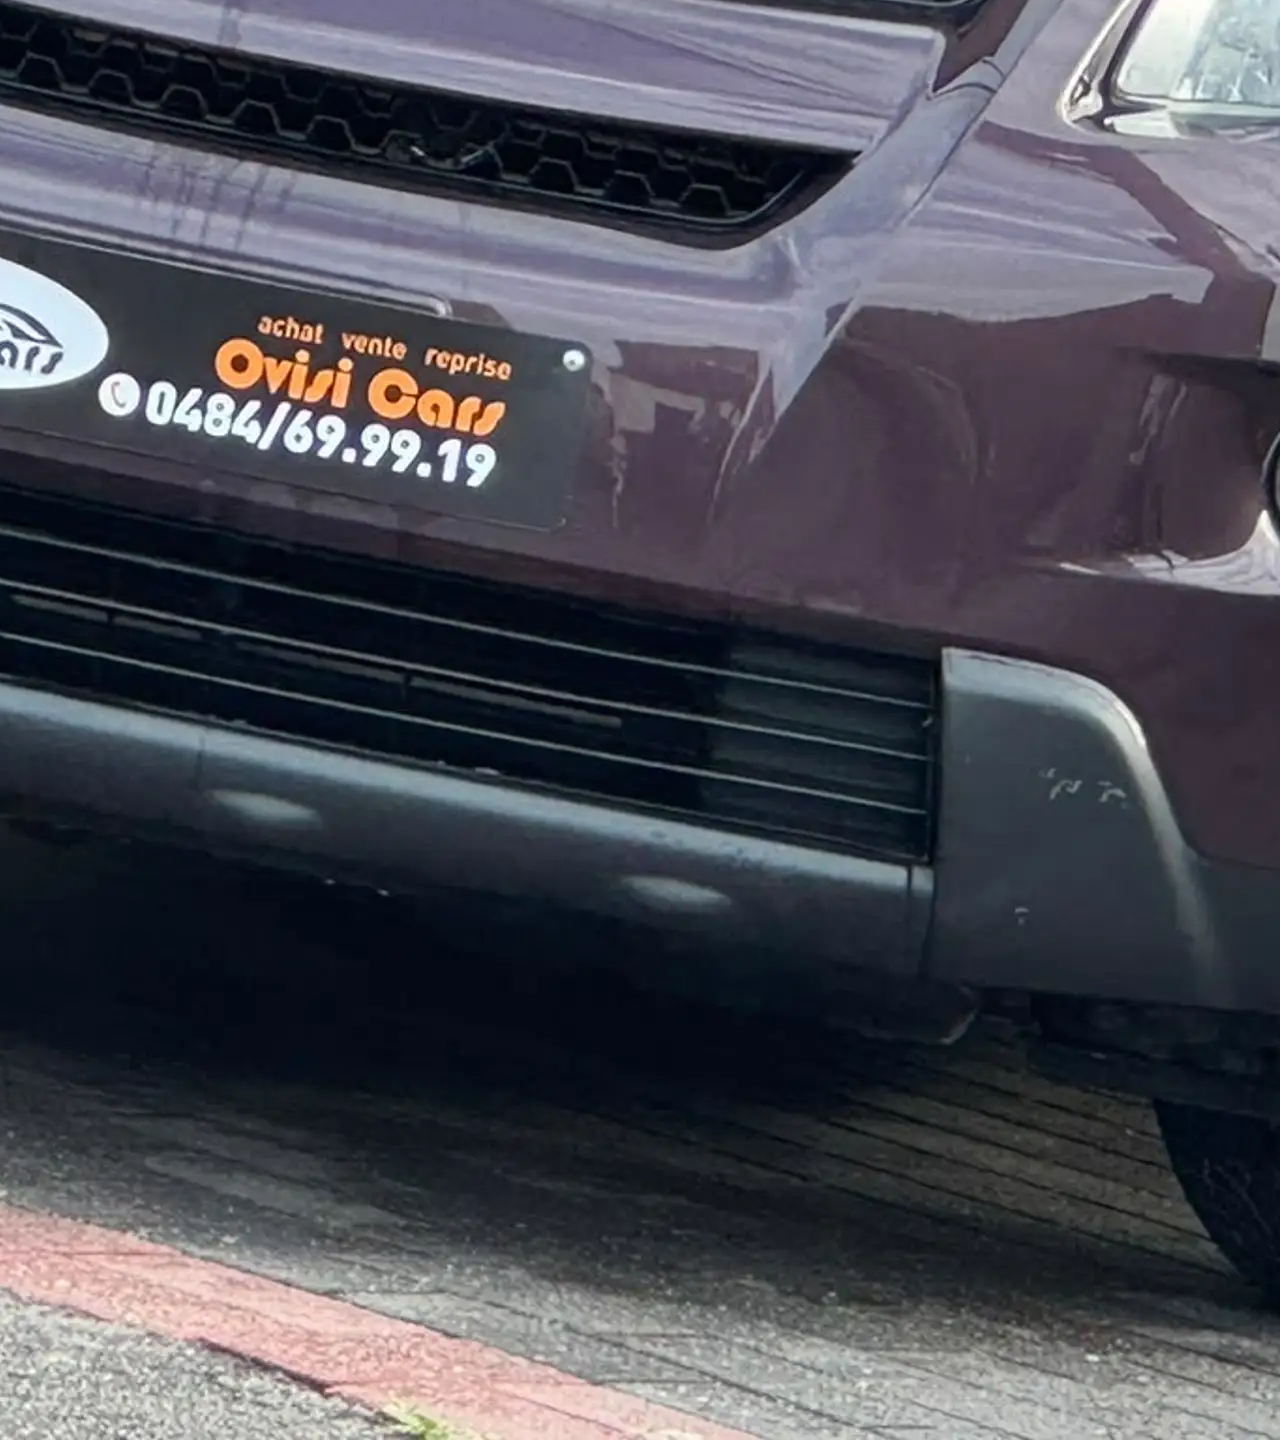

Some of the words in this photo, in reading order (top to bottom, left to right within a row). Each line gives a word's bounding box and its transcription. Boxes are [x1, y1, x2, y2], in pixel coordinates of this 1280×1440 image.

[214, 338, 354, 409] Ovisi
[367, 367, 506, 436] Cars
[257, 315, 324, 344] achat
[341, 331, 408, 360] vente
[424, 346, 513, 381] reprise
[145, 380, 497, 488] 0484/69.99.19
